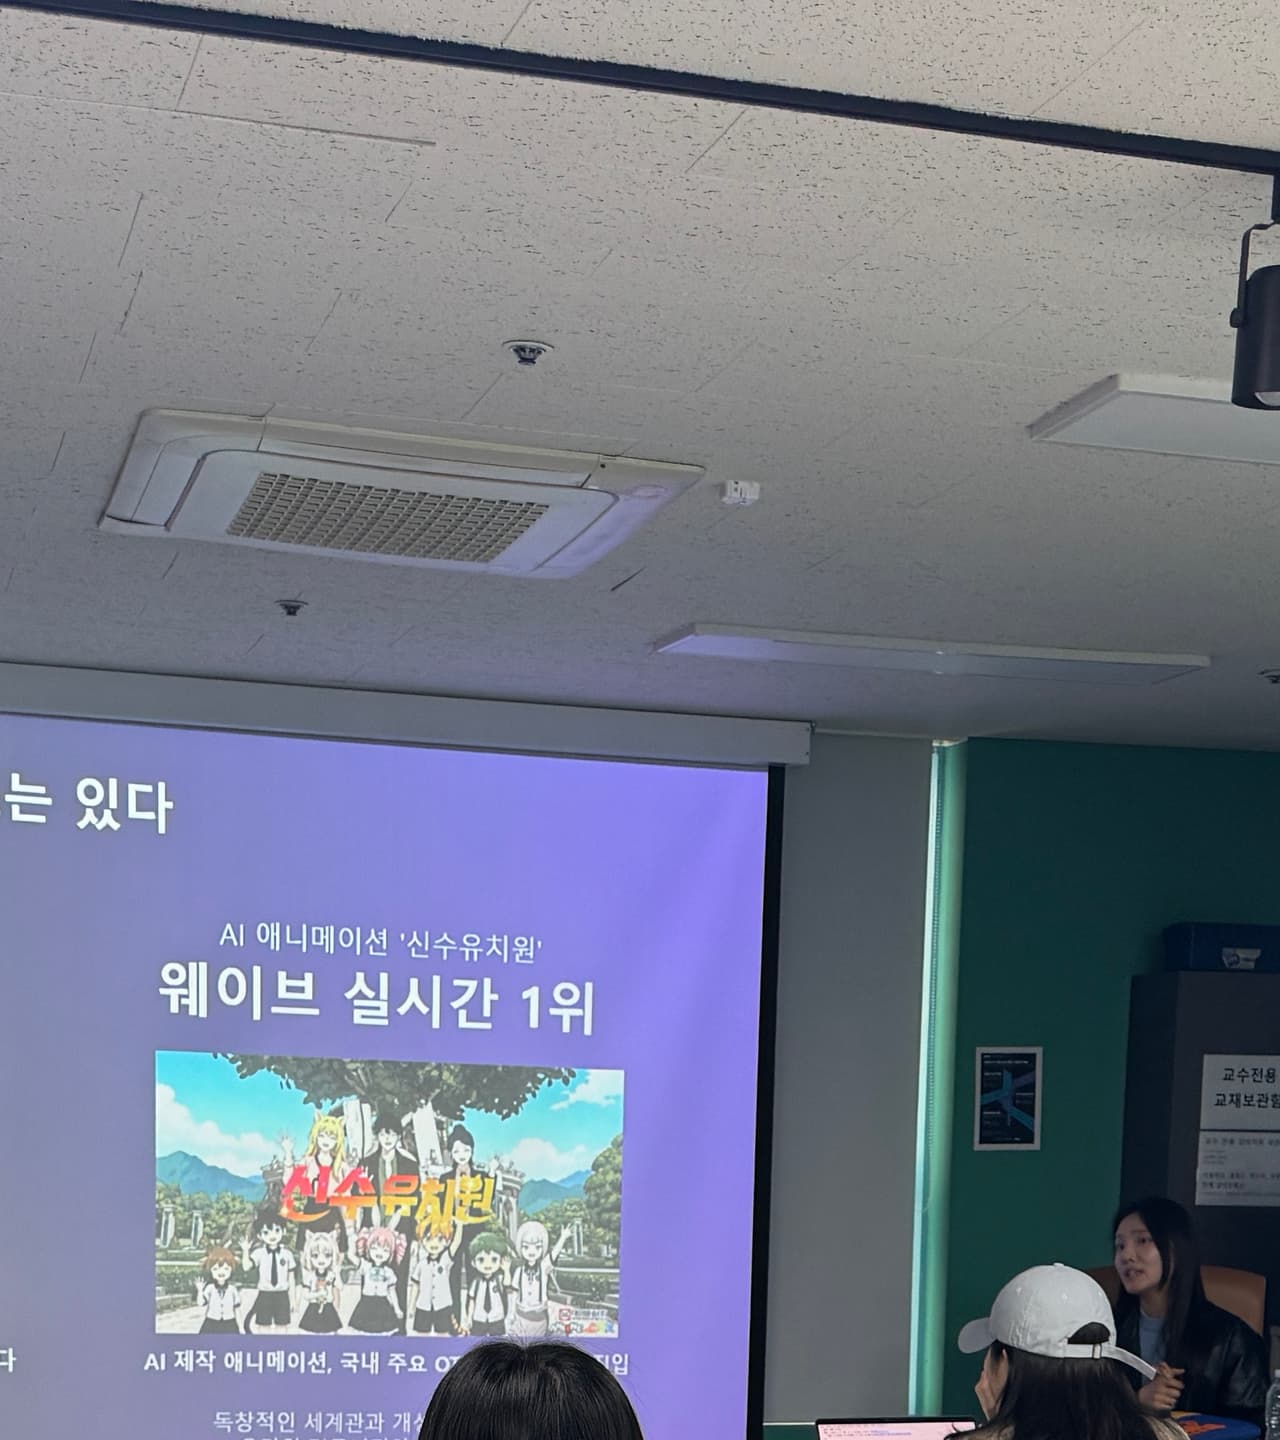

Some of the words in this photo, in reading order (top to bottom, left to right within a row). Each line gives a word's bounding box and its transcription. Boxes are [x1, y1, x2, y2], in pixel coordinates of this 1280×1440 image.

[76, 777, 174, 835] 있다
[219, 923, 245, 947] AI
[256, 922, 389, 957] 애니메이션
[400, 932, 543, 965] '신수유치원'
[158, 960, 321, 1021] 웨이브
[343, 971, 499, 1030] 실시간
[520, 980, 595, 1036] 1위
[1223, 1067, 1277, 1084] 교수전용
[144, 1353, 166, 1371] AI
[173, 1349, 217, 1374] 제작
[224, 1350, 333, 1375] 애니메이션,
[340, 1351, 380, 1375] 국내
[387, 1353, 428, 1374] 주요
[213, 1411, 296, 1434] 독창적인
[304, 1411, 384, 1434] 세계관과
